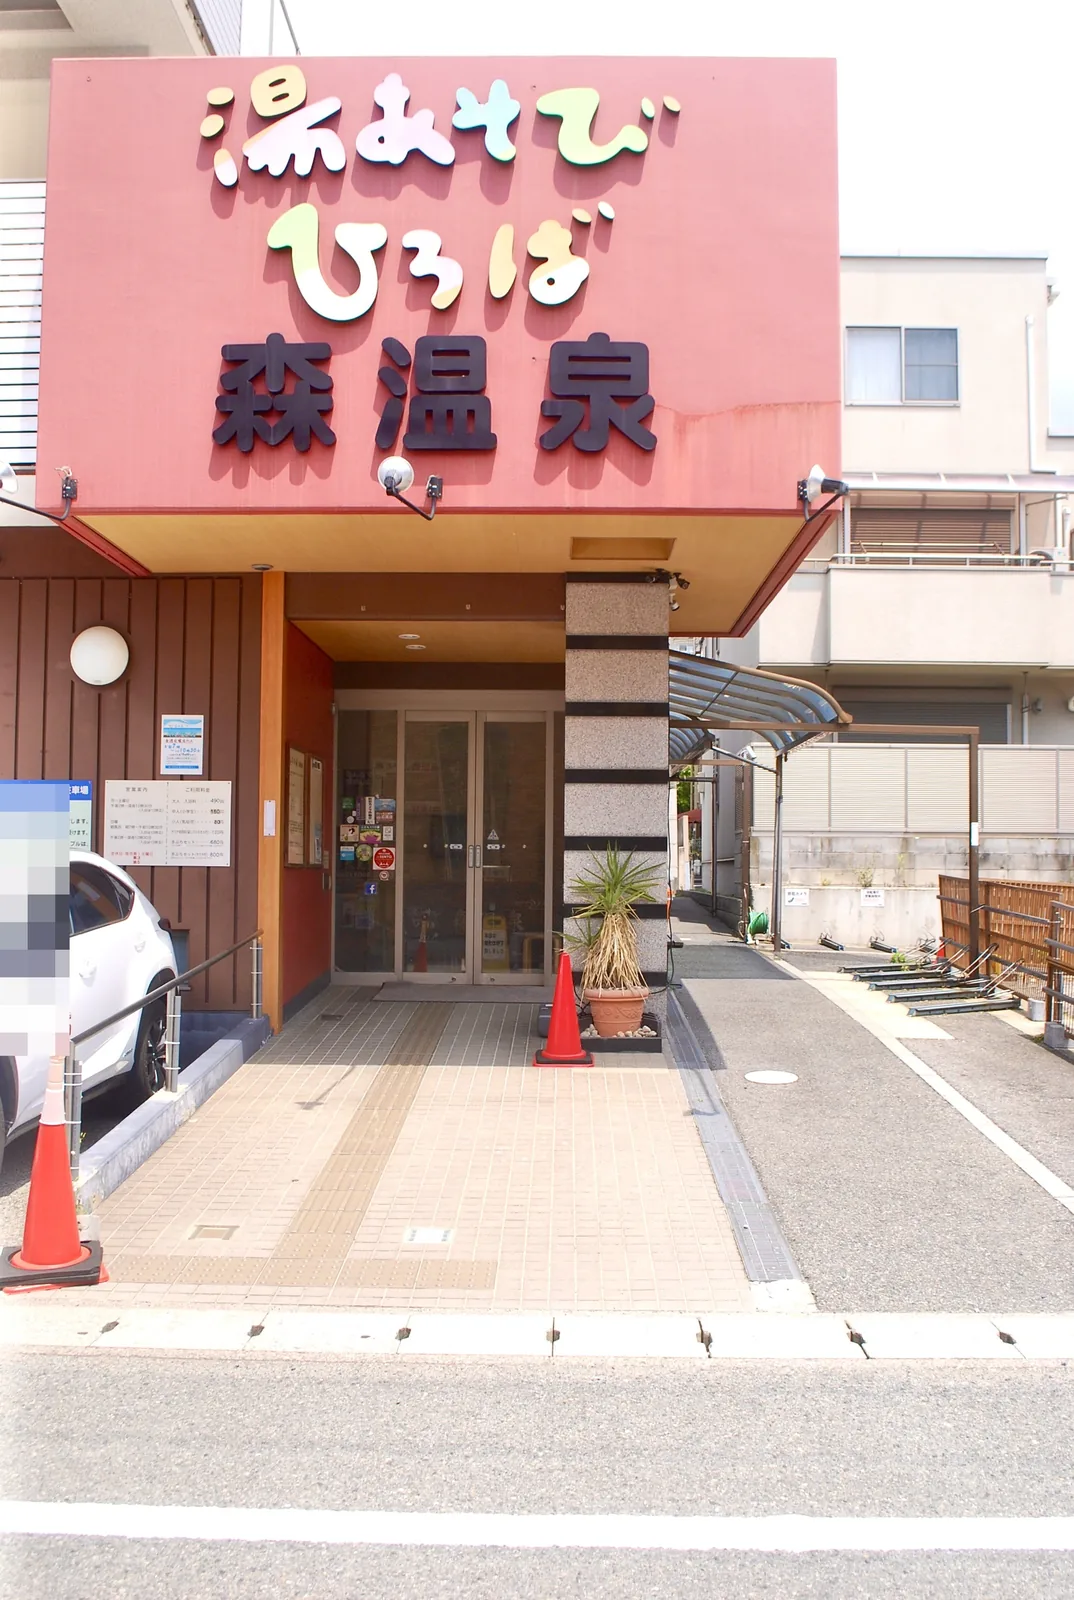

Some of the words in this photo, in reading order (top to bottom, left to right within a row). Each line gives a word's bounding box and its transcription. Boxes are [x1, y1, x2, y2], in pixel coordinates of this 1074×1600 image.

[200, 65, 681, 187] 湯あそび
[267, 201, 616, 322] ひろば
[212, 332, 658, 453] 森温泉
